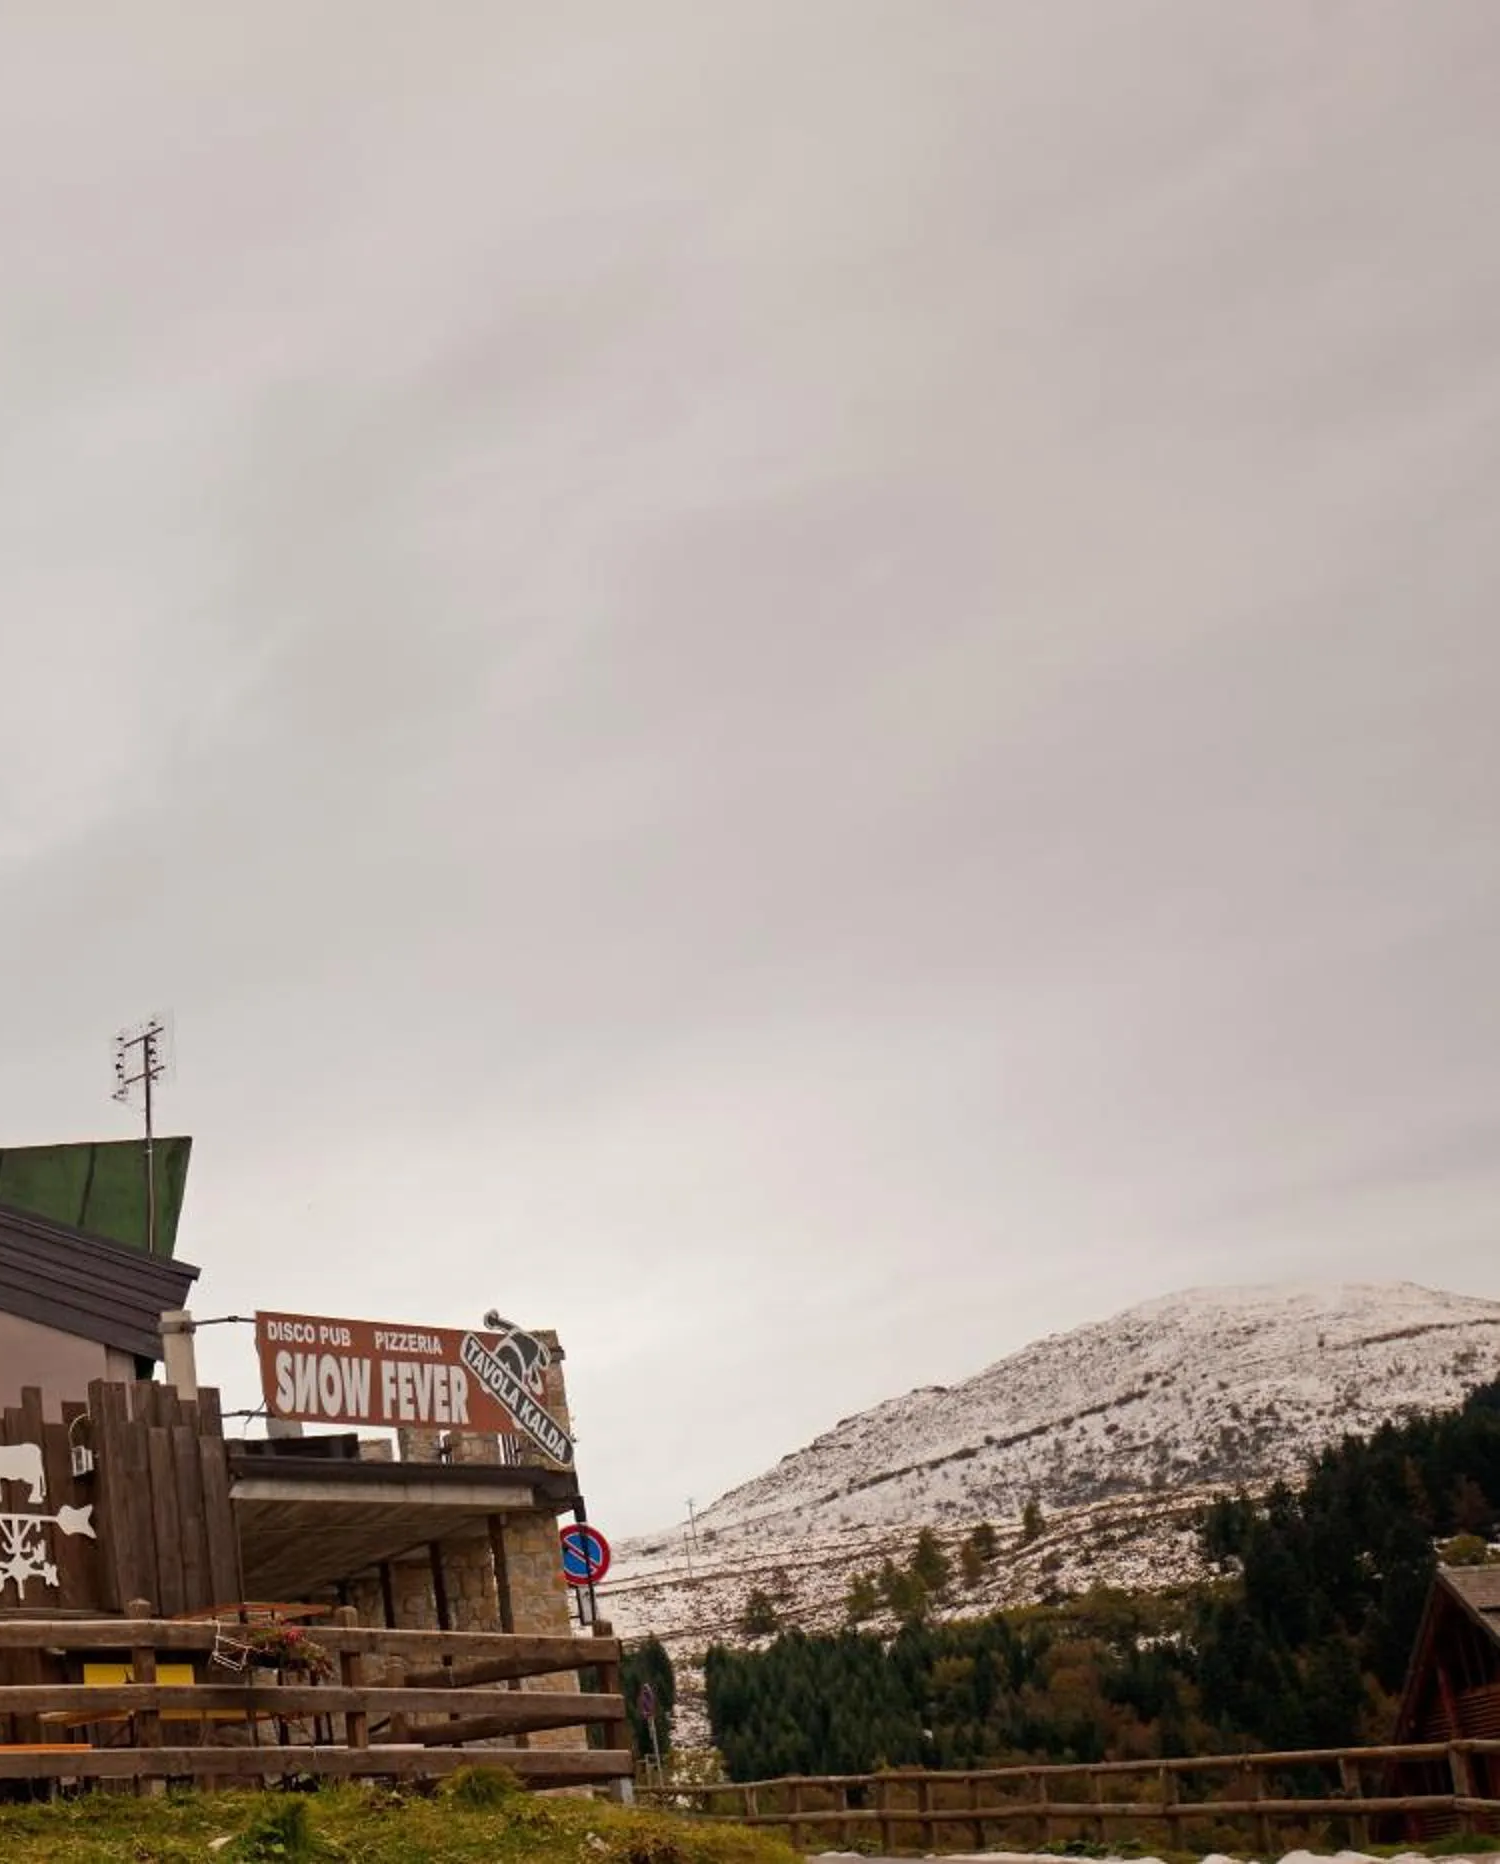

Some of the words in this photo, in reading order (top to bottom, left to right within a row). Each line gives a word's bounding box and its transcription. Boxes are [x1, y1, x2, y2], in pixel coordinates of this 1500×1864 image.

[267, 1320, 315, 1344] DISCO
[319, 1326, 351, 1347] PUB
[374, 1331, 443, 1355] PIZZERIA
[275, 1350, 372, 1417] SNOW
[380, 1360, 470, 1425] FEVER
[466, 1339, 521, 1412] TAVOLA
[518, 1399, 567, 1461] KALDA
